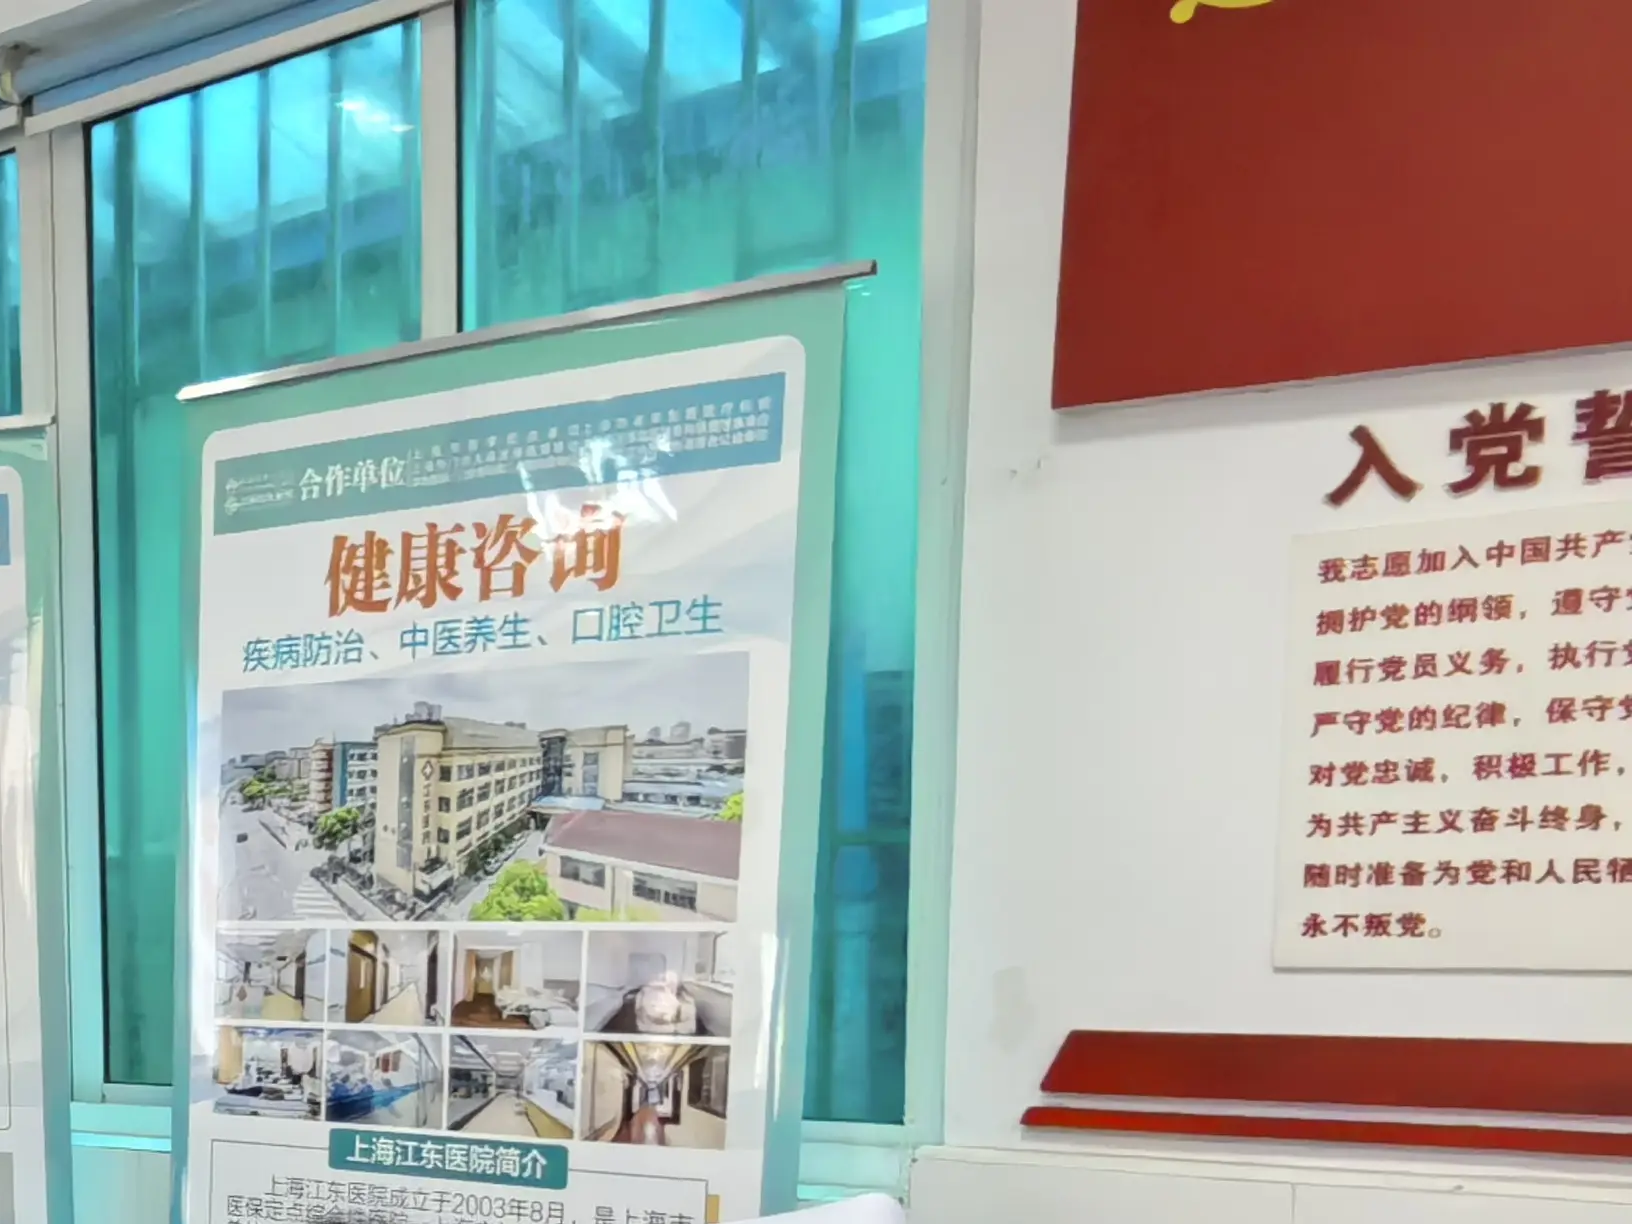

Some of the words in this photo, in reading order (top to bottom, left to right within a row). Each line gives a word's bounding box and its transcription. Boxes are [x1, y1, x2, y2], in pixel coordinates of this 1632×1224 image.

[299, 456, 406, 501] 合作单位
[324, 504, 629, 618] 健康咨询
[1318, 530, 1632, 584] 我志愿加入中国共产
[242, 592, 725, 674] 疾病防治、中医养生、口腔卫生
[1316, 585, 1632, 636] 拥护党的纲领，遵守
[1313, 640, 1632, 687] 履行党员义务，执行
[1308, 749, 1625, 788] 对党忠诚，积极工作，
[1306, 804, 1623, 839] 为共产主义奋斗终身，
[1301, 913, 1442, 939] 永不叛党。
[346, 1136, 548, 1180] 上海江东医院简介
